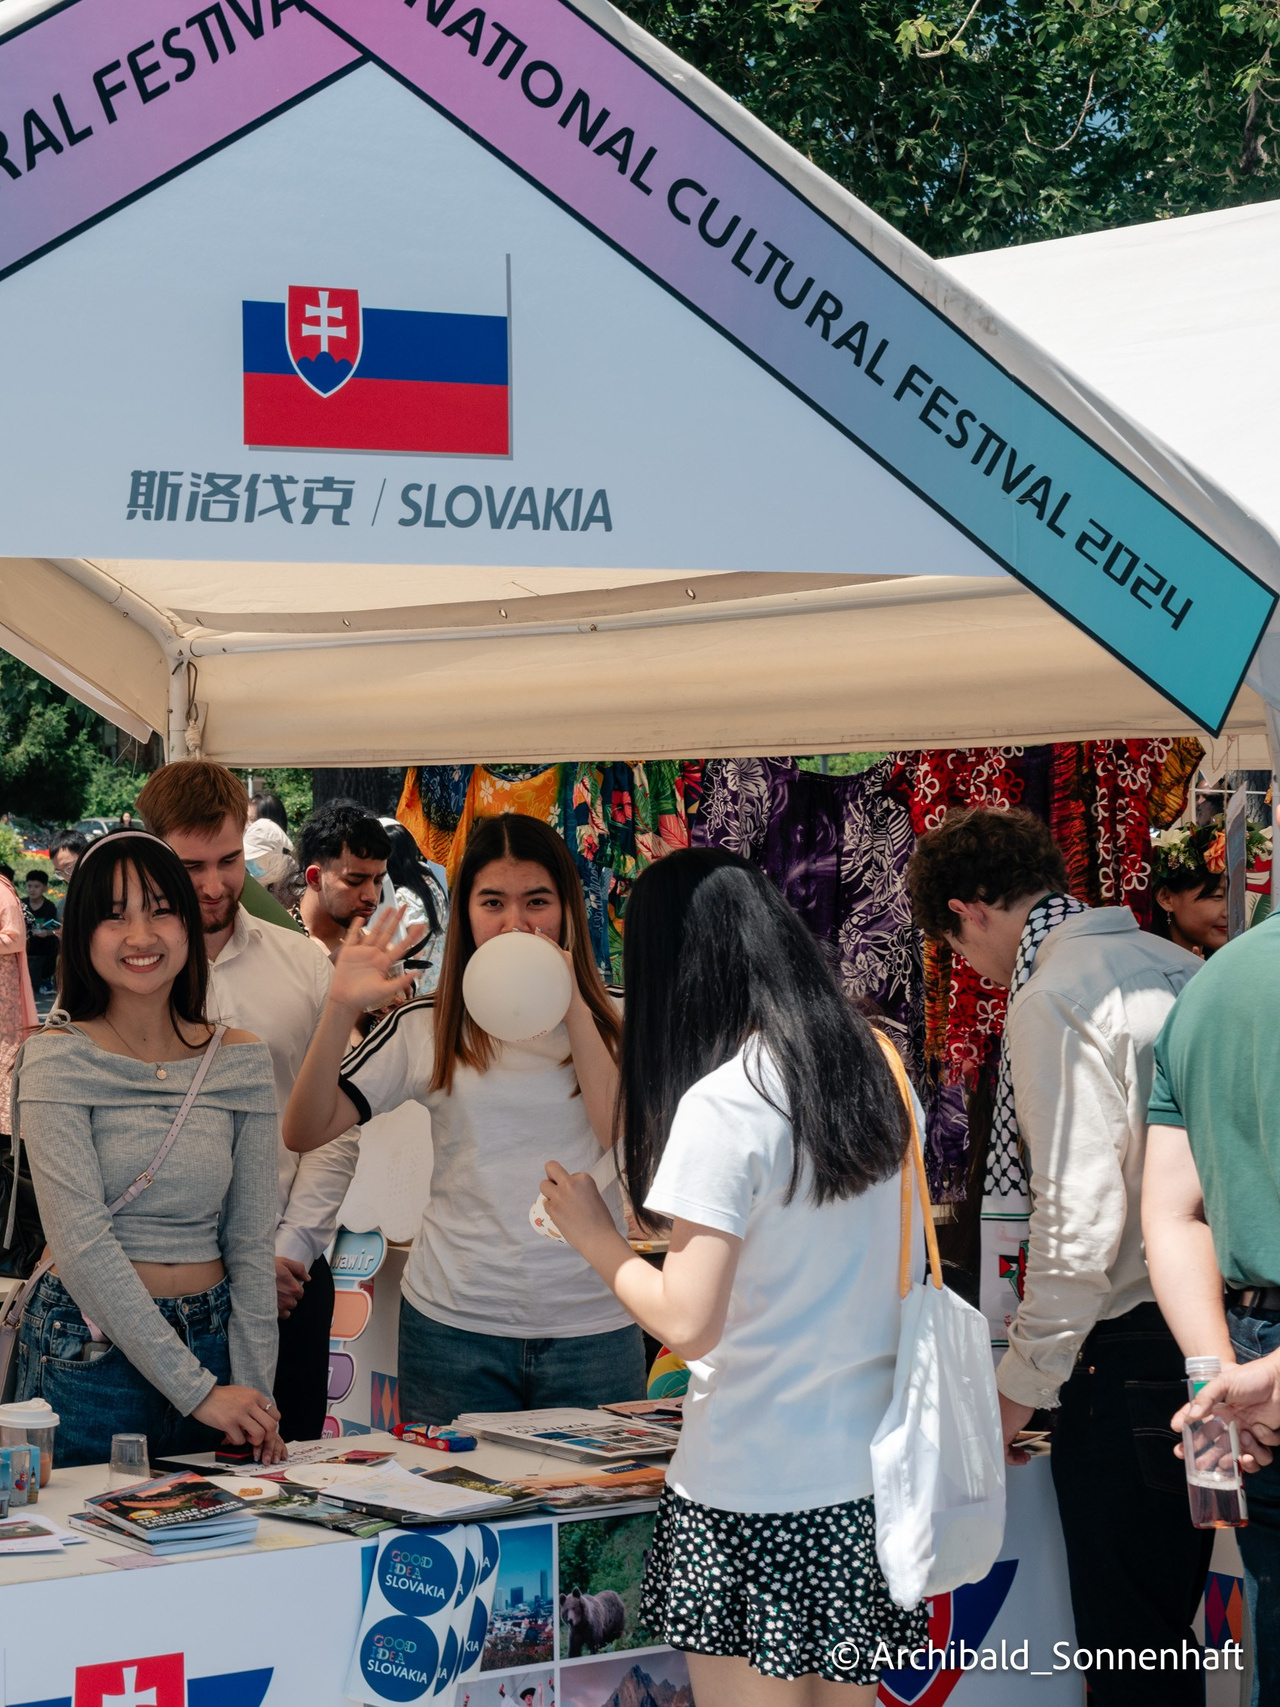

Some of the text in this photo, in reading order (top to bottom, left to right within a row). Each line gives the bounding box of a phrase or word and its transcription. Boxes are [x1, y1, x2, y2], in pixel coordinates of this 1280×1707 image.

[405, 0, 1194, 631] NATIONAL CULTURAL FESTIVAL 2024
[126, 469, 356, 526] 斯洛伐克
[397, 482, 613, 533] SLOVAKIA
[388, 1561, 422, 1580] IDEA
[391, 1550, 433, 1569] GOOD
[385, 1574, 446, 1600] SLOVAKIA
[370, 1646, 405, 1665] IDEA
[374, 1634, 417, 1654] GOOD
[367, 1659, 428, 1685] SLOVAKIA
